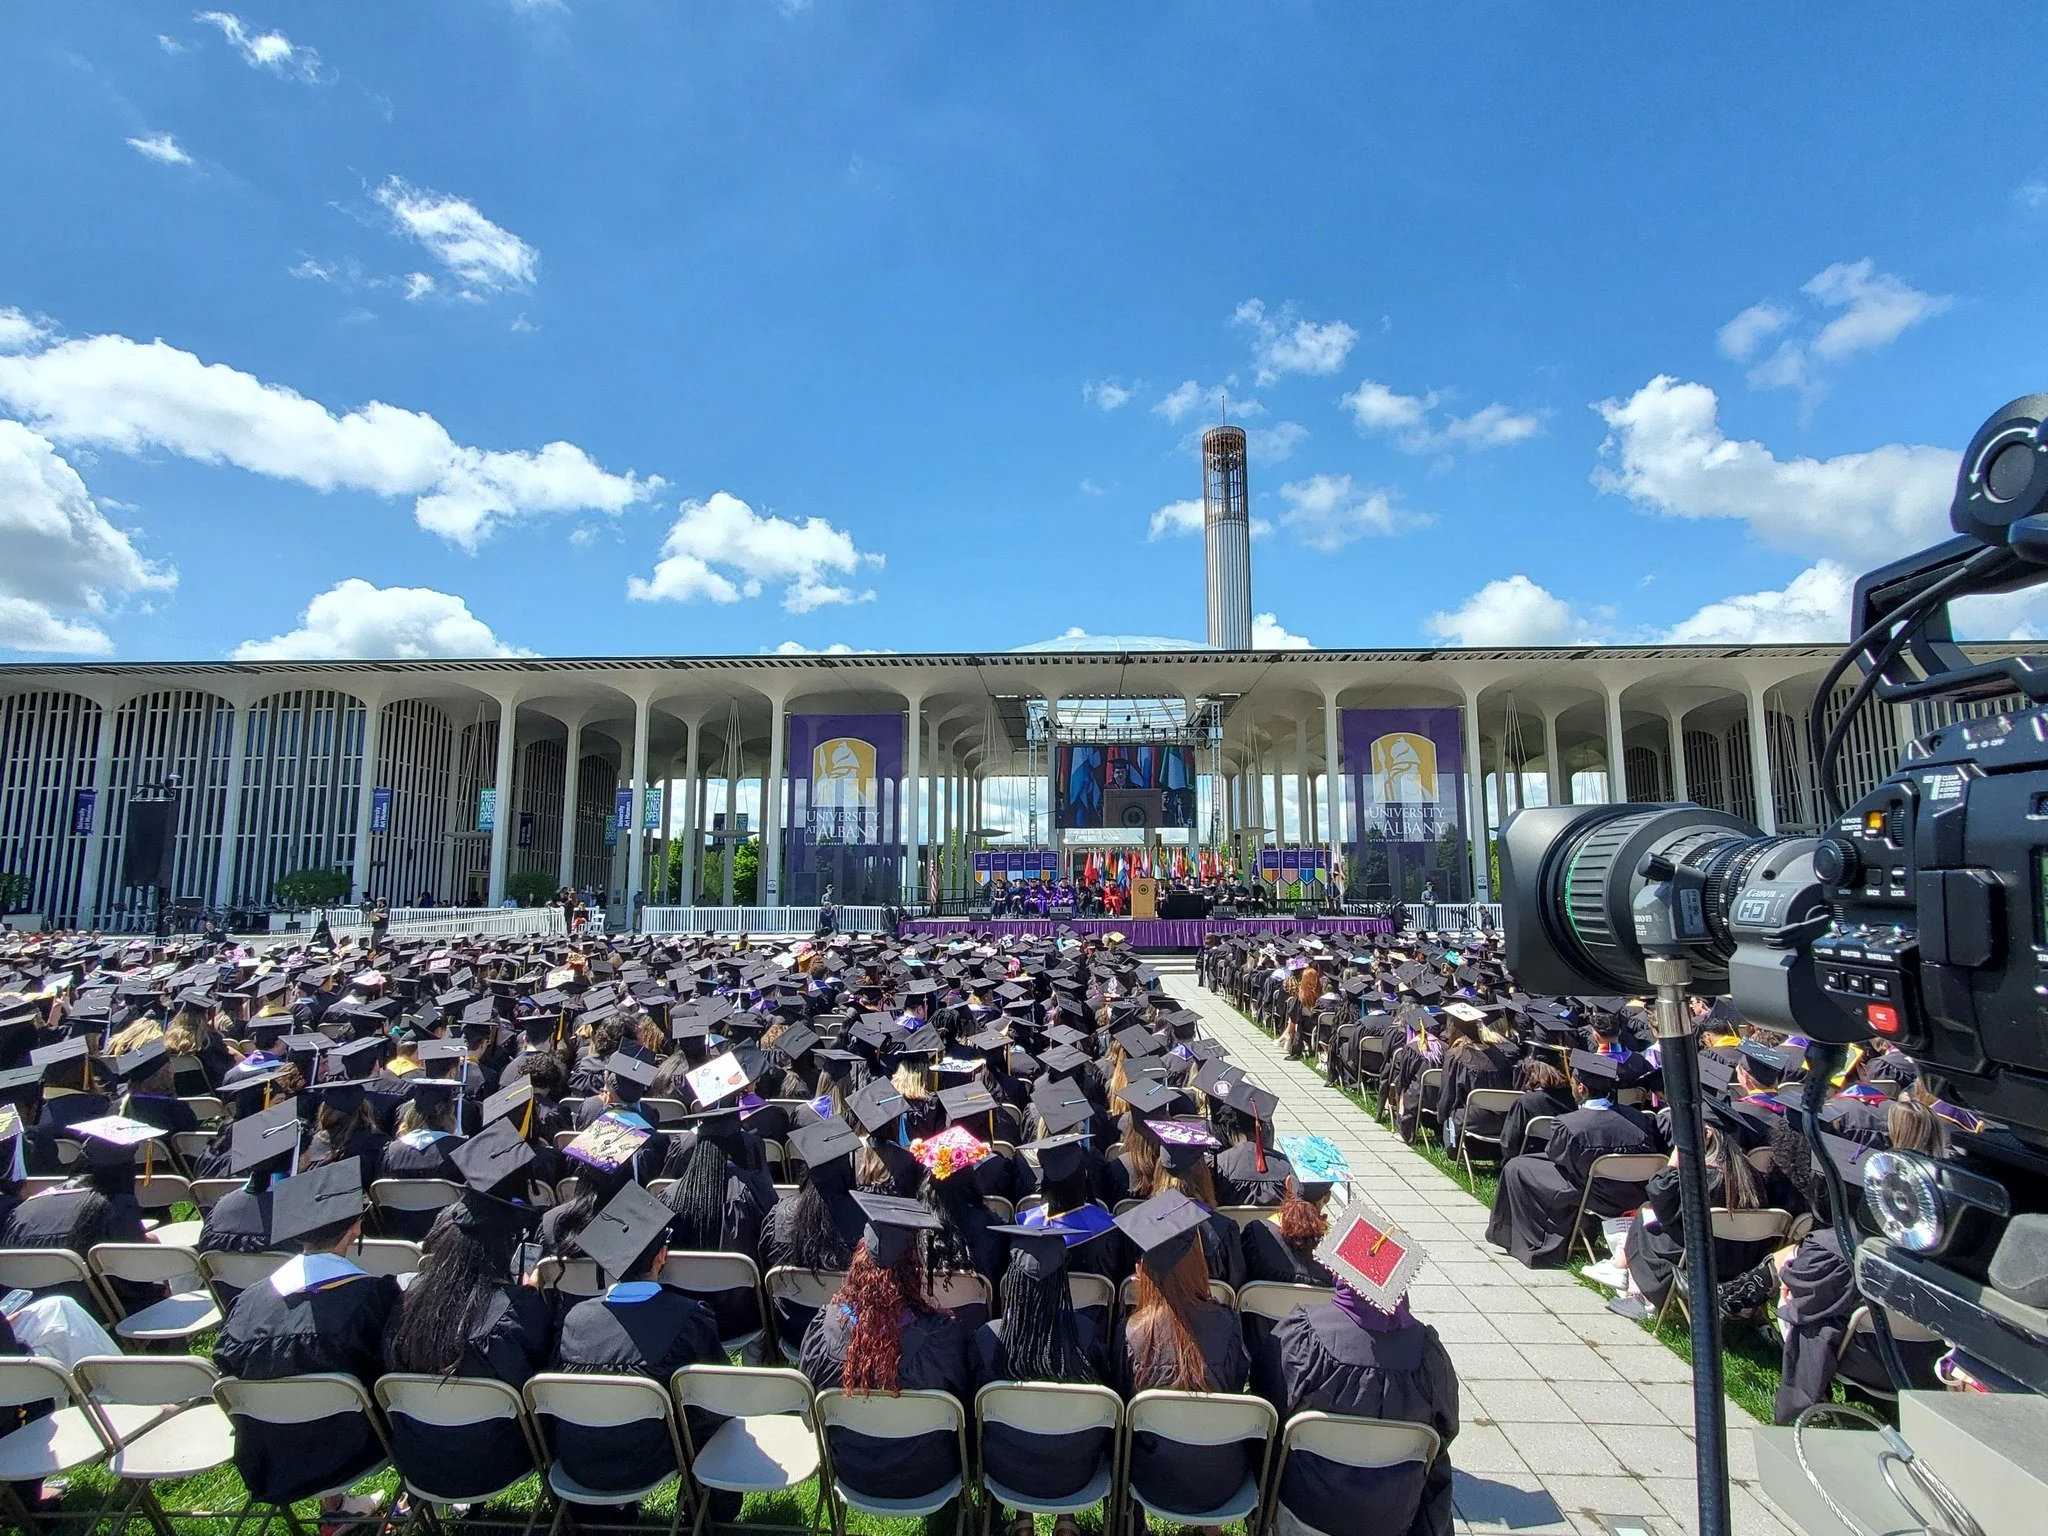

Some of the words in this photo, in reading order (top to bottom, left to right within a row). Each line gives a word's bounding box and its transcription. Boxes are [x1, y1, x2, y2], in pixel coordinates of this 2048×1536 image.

[646, 790, 660, 801] FREE
[480, 801, 495, 811] AND
[646, 801, 660, 812] AND
[806, 810, 880, 822] UNIVERSITY
[1369, 806, 1445, 819] UNIVERSITY
[805, 825, 817, 834] AT
[818, 823, 880, 840] ALBANY
[1370, 821, 1382, 830] AT
[1382, 819, 1445, 839] ALBANY
[1746, 889, 1777, 898] Canon
[1739, 902, 1766, 919] HD
